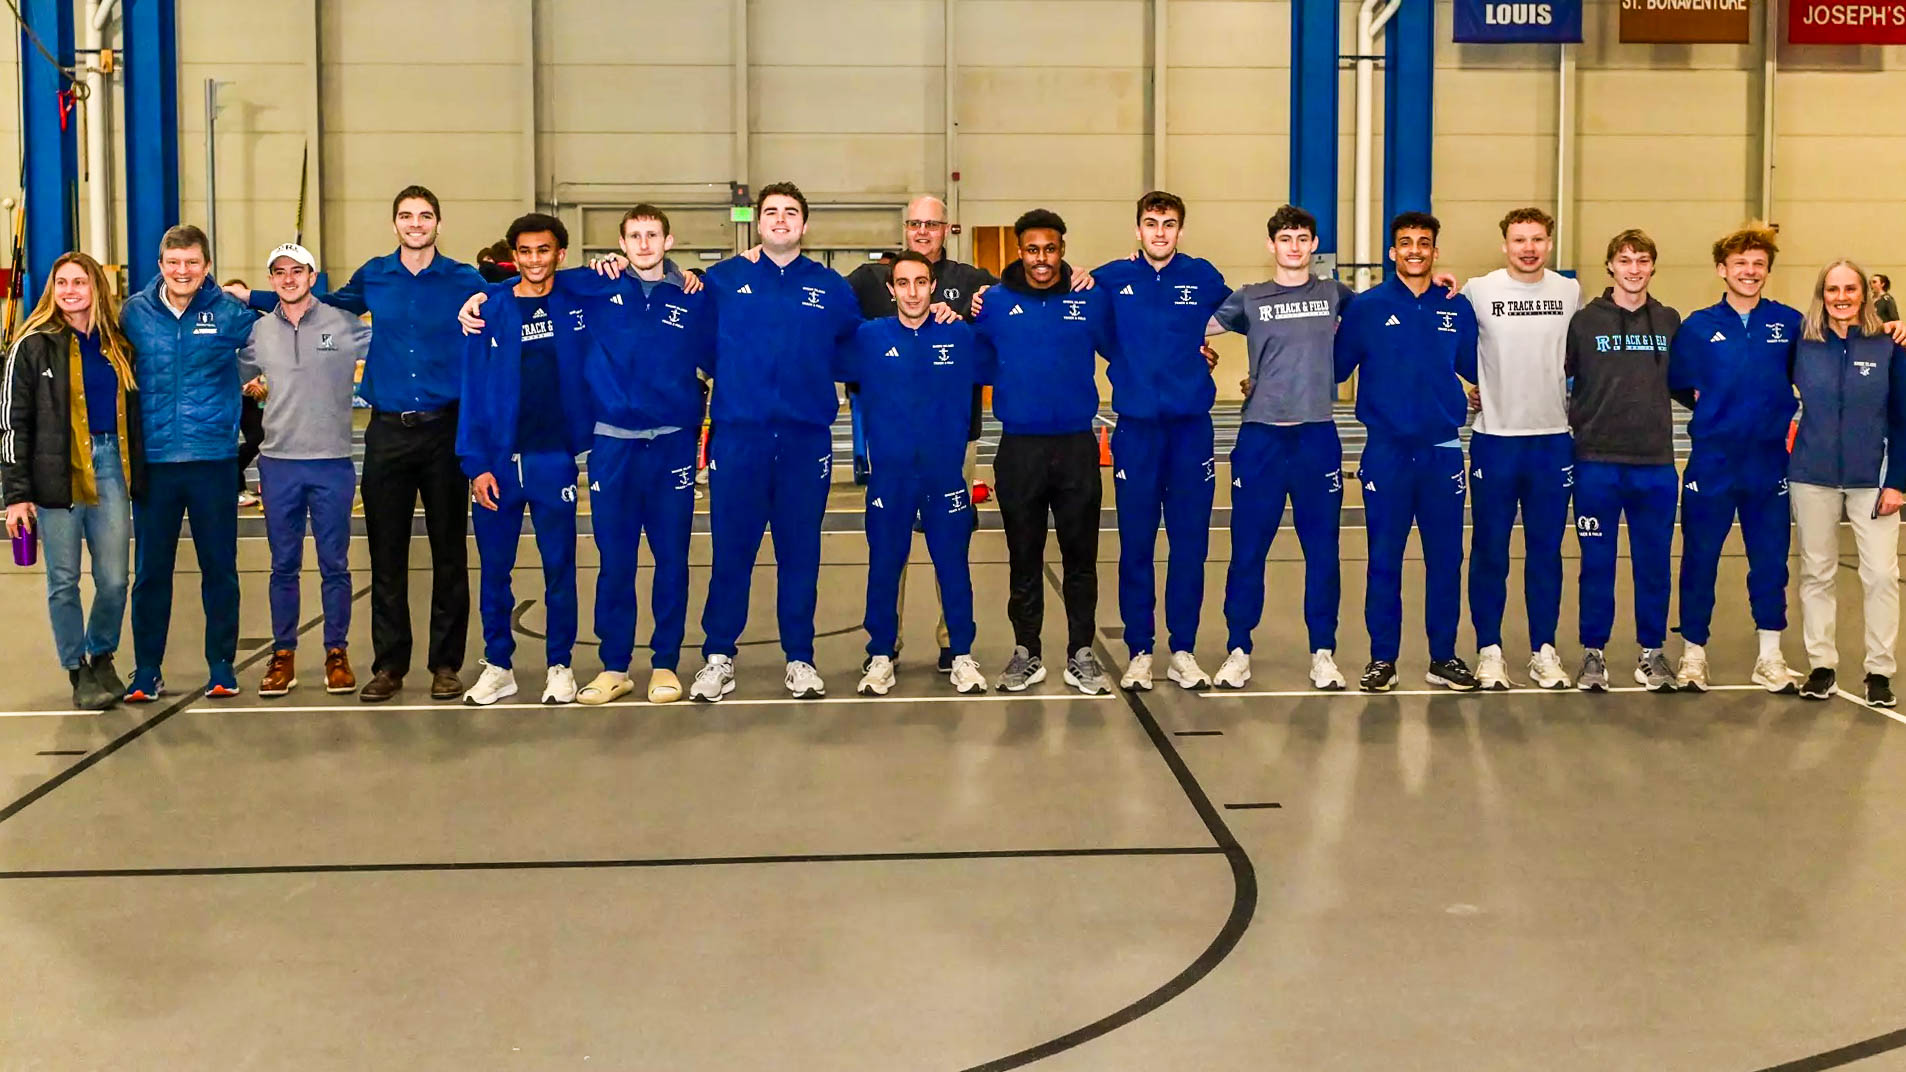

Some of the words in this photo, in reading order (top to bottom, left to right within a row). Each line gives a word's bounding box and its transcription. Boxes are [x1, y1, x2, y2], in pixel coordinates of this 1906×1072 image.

[1485, 4, 1552, 25] LOUIS
[1803, 5, 1906, 25] JOSEPH'S
[1274, 302, 1301, 315] TRACK
[1302, 301, 1309, 312] &
[1309, 300, 1329, 312] FIELD
[1507, 300, 1534, 311] TRACK
[1536, 300, 1542, 310] &
[1543, 300, 1563, 310] FIELD
[1612, 334, 1641, 346] TACK
